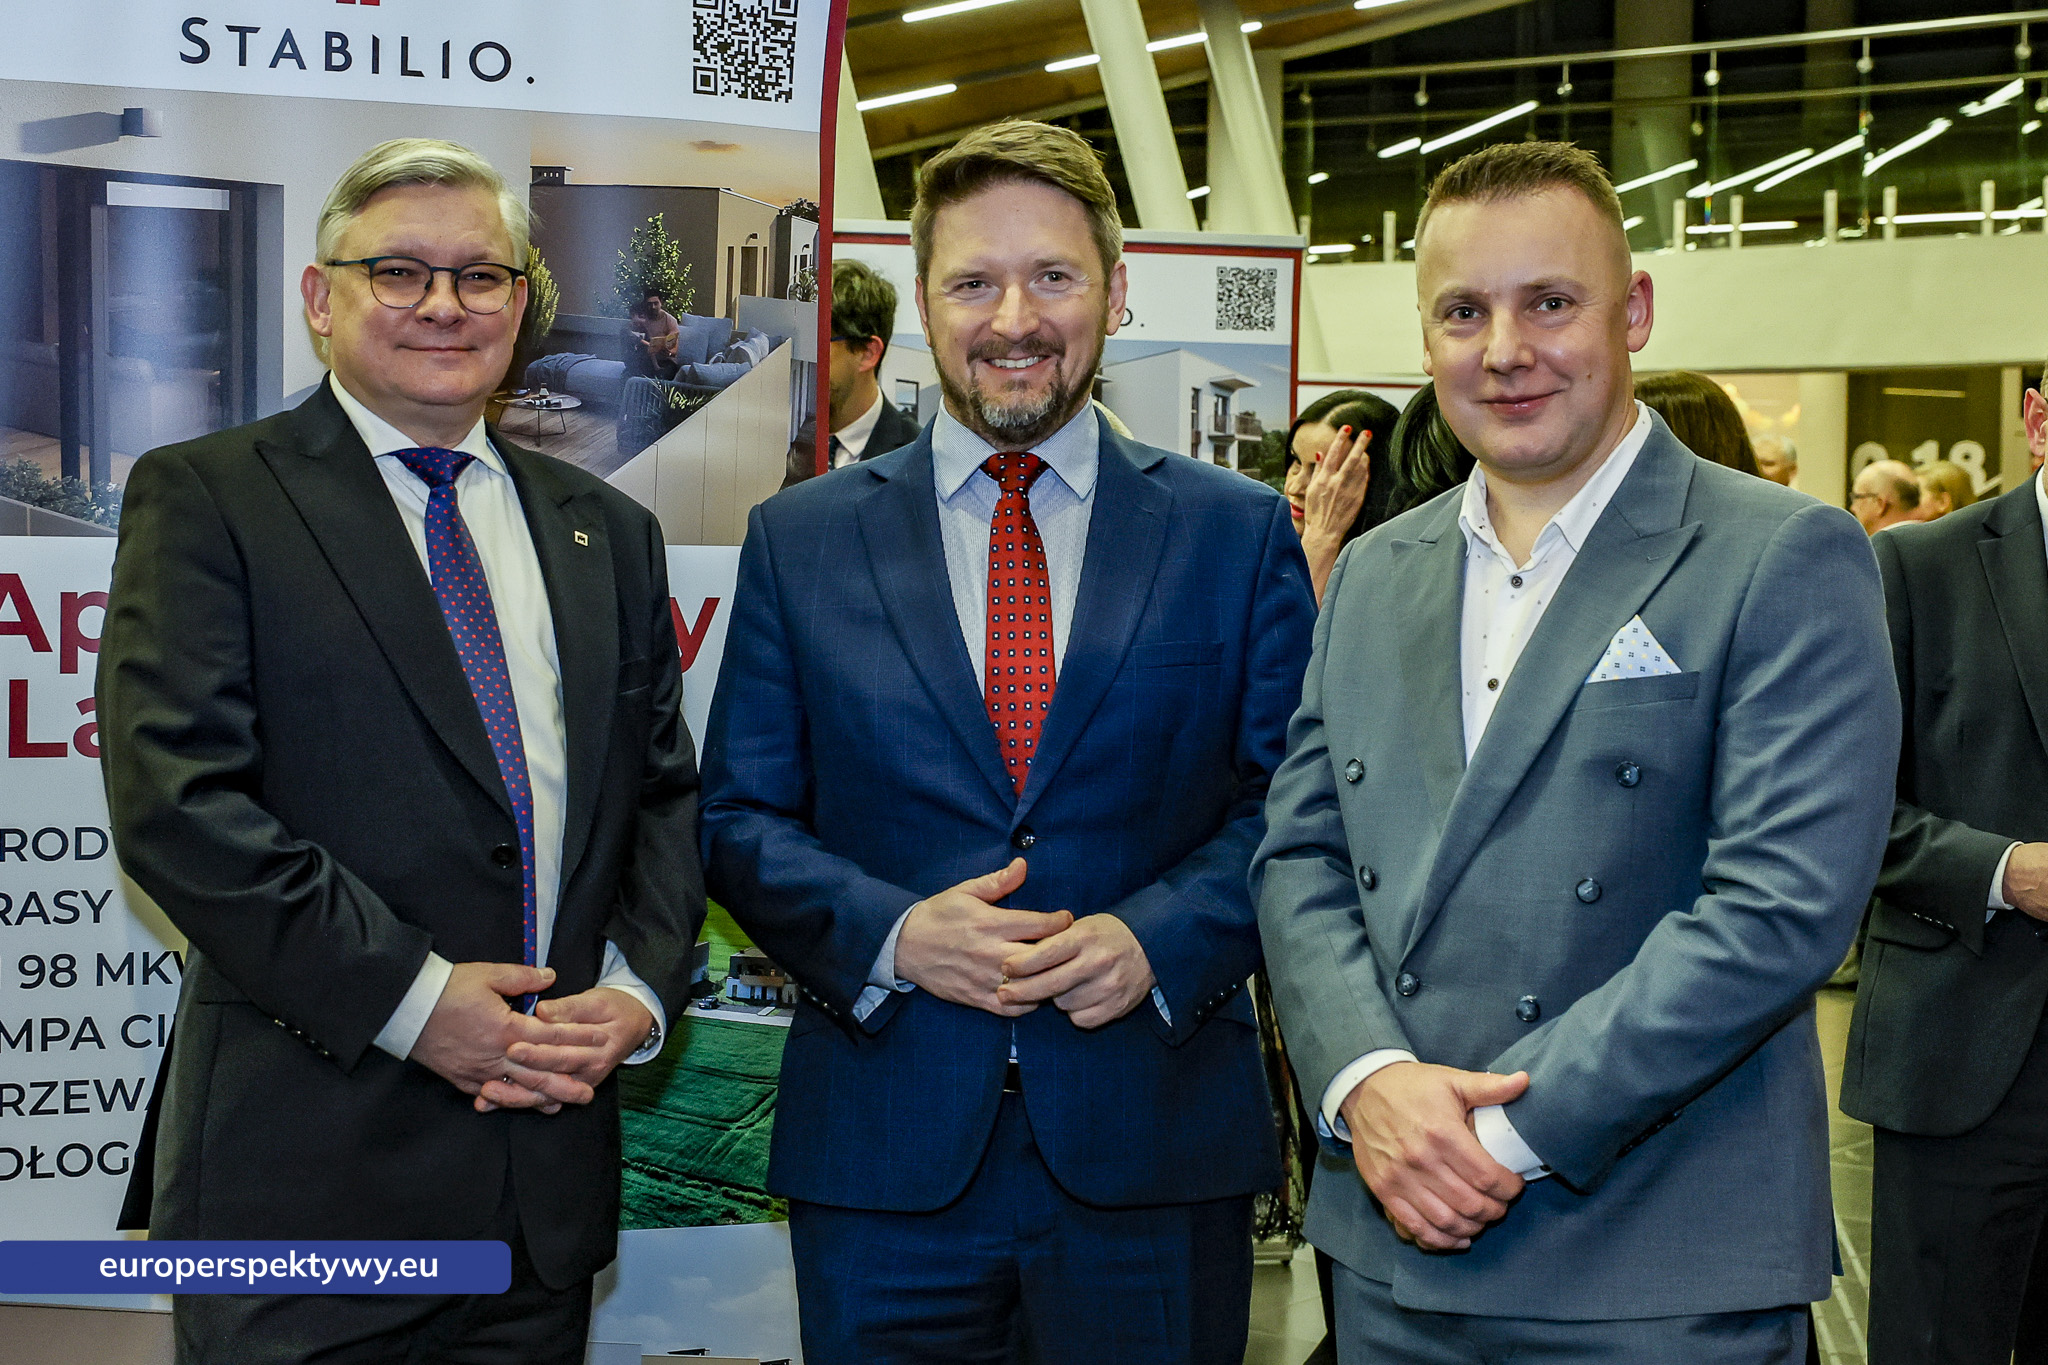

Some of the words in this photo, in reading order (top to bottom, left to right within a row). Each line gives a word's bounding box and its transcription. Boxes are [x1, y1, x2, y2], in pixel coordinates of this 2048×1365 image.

[178, 16, 535, 86] STABILIO.
[0, 826, 112, 862] ROD
[18, 953, 78, 989] 98
[96, 950, 184, 987] MK
[120, 1013, 176, 1049] CI
[0, 1077, 150, 1118] RZEW
